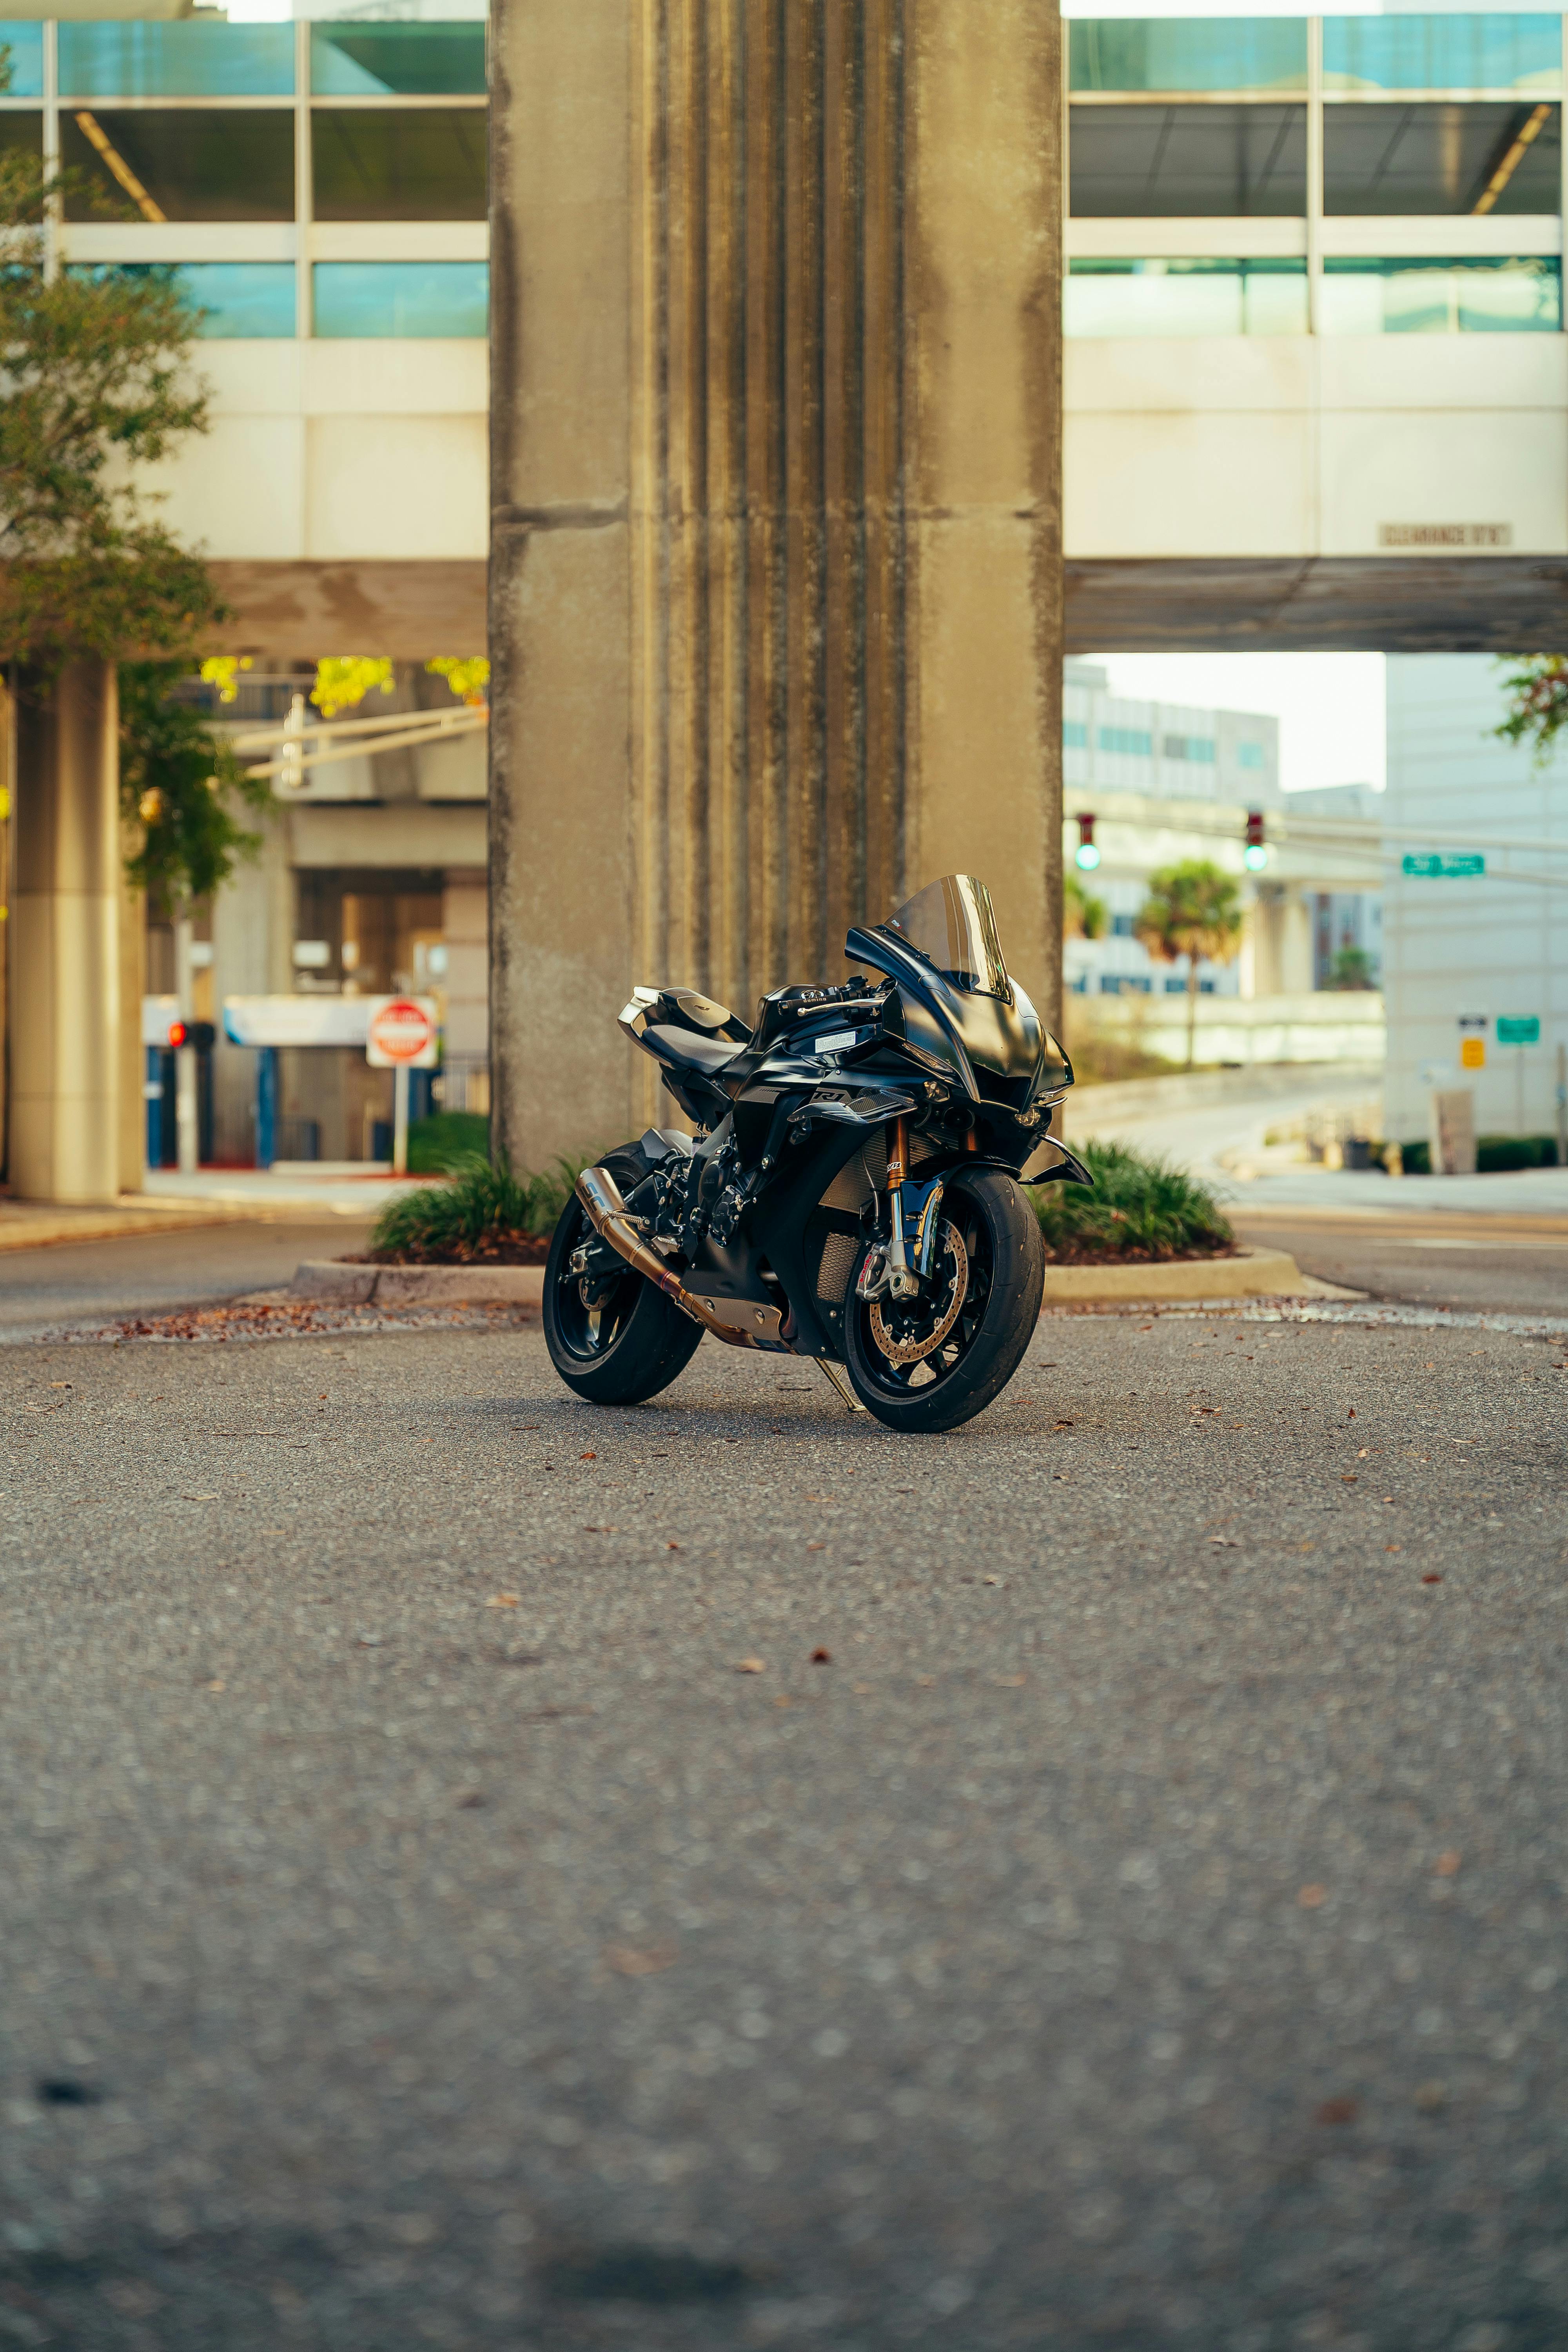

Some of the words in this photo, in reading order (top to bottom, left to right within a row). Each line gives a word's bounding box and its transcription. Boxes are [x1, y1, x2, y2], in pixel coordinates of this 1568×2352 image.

[813, 1090, 846, 1101] R1
[581, 1182, 605, 1212] SC
[859, 1255, 872, 1282] brembo
